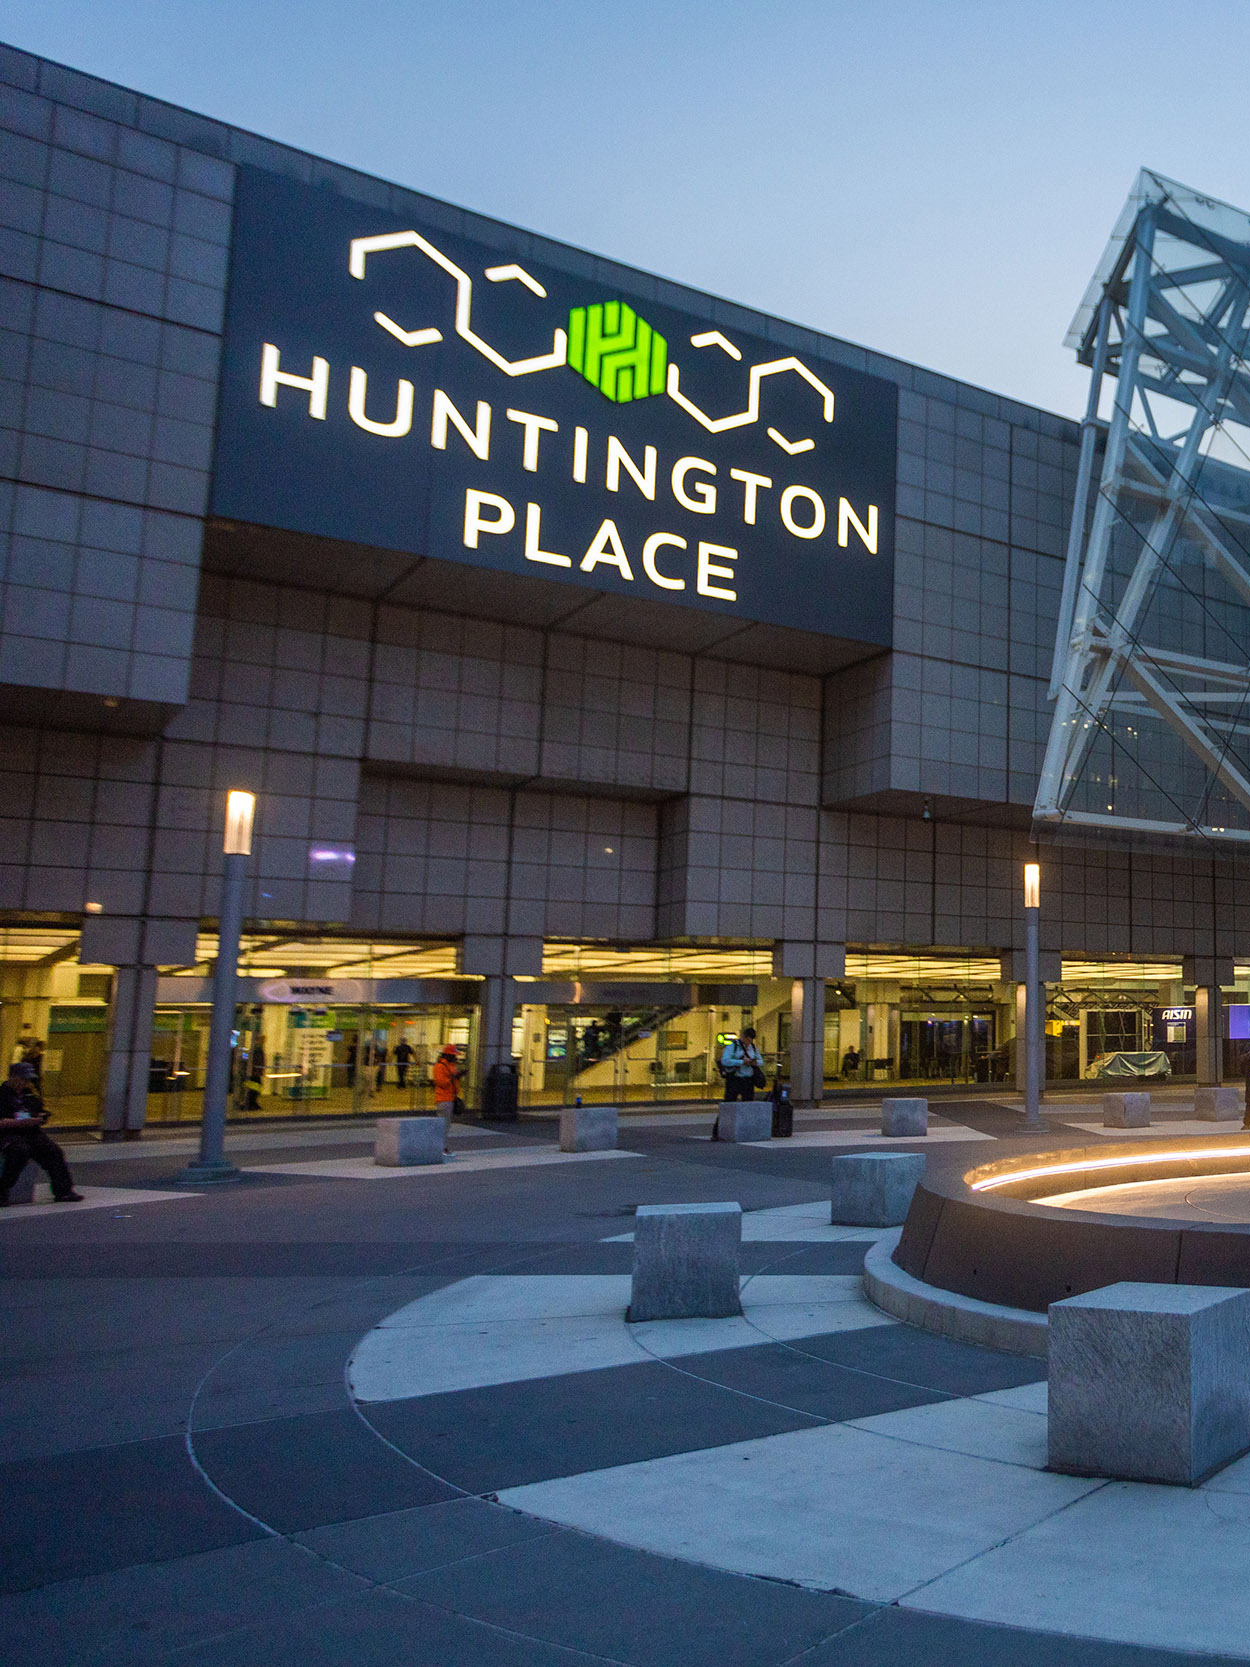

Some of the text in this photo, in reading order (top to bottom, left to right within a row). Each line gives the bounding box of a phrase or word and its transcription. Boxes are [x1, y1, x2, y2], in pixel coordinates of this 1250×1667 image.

[258, 342, 879, 555] HUNTINGTON
[463, 488, 739, 602] PLACE
[1162, 1010, 1192, 1020] AISIN
